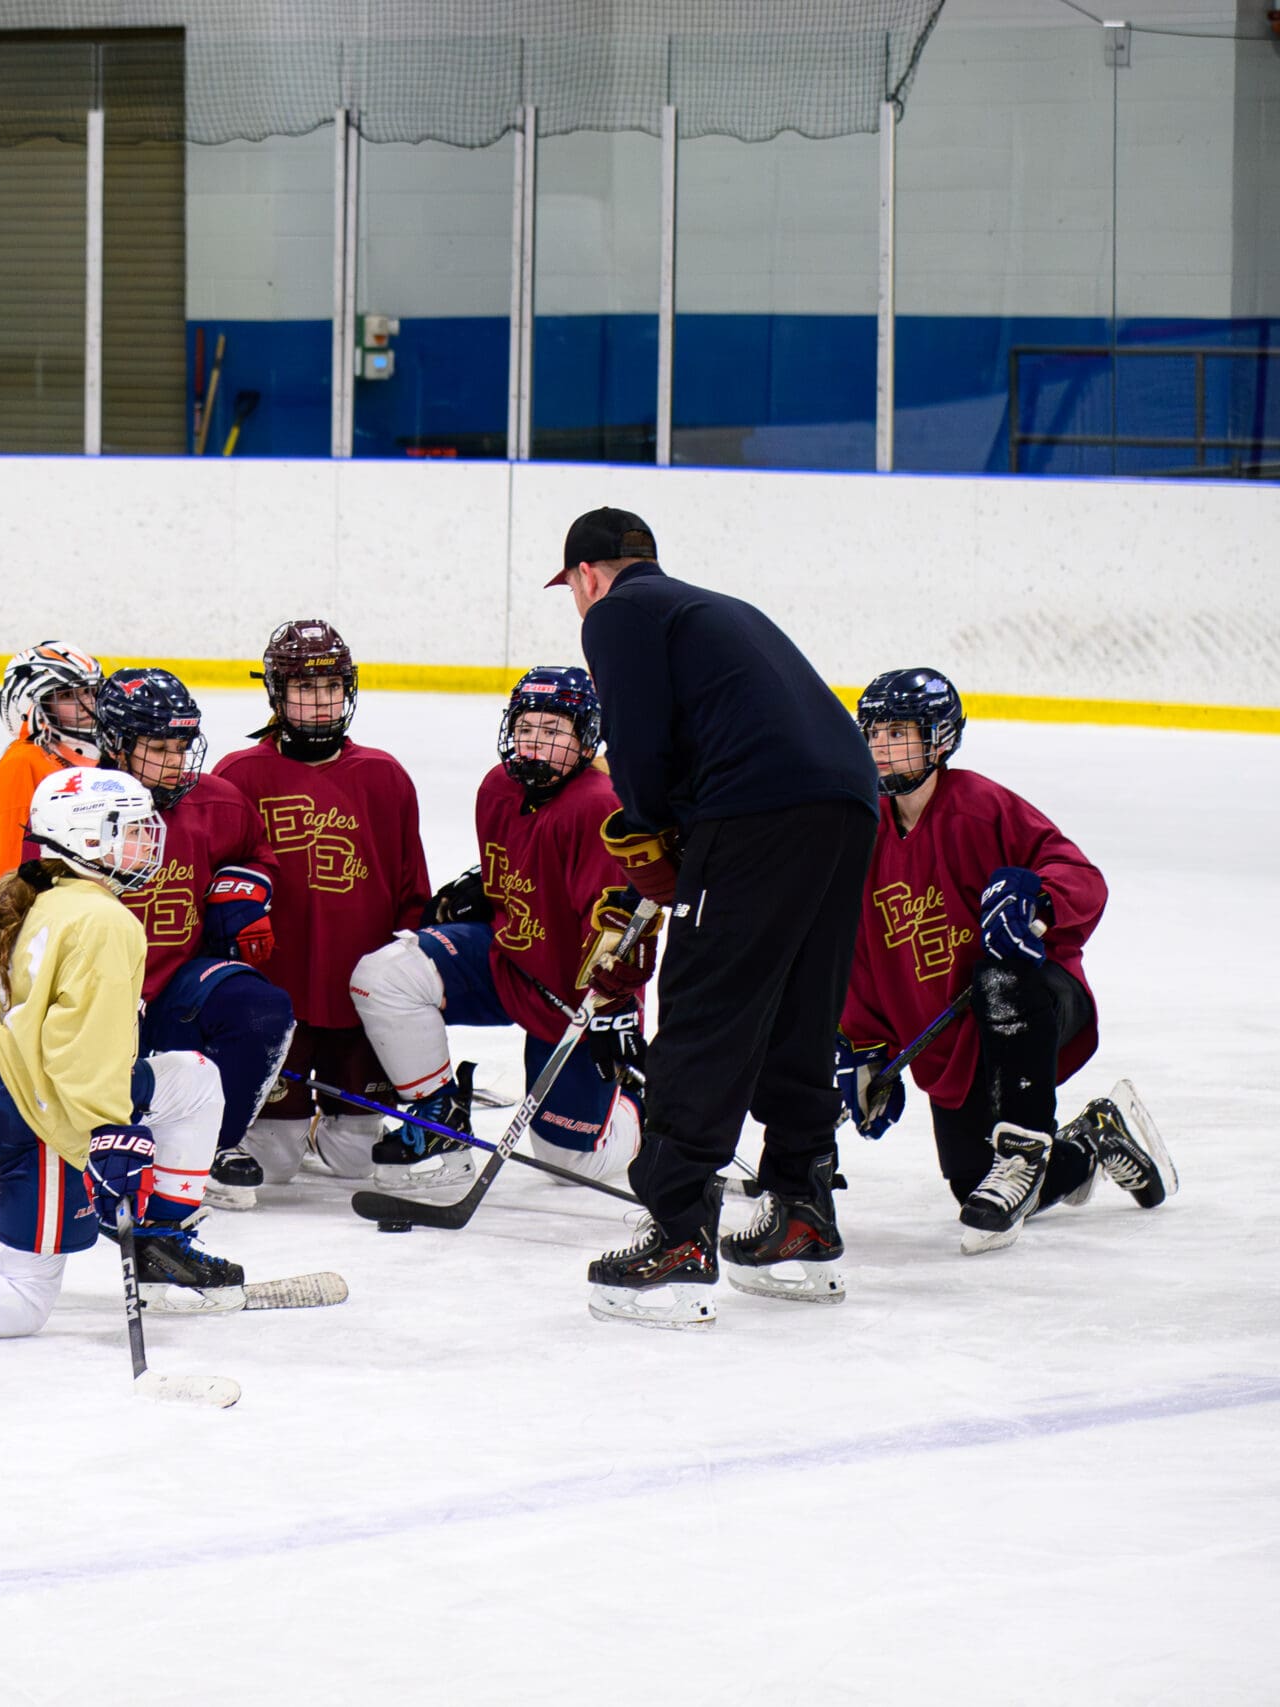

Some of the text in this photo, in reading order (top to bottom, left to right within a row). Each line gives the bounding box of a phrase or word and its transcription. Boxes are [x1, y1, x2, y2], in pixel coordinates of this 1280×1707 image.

[259, 794, 360, 854] Eagles
[307, 834, 369, 894] Elite
[495, 1093, 540, 1161] BAUER
[540, 1110, 602, 1135] BAUER
[121, 1256, 140, 1322] CCM
